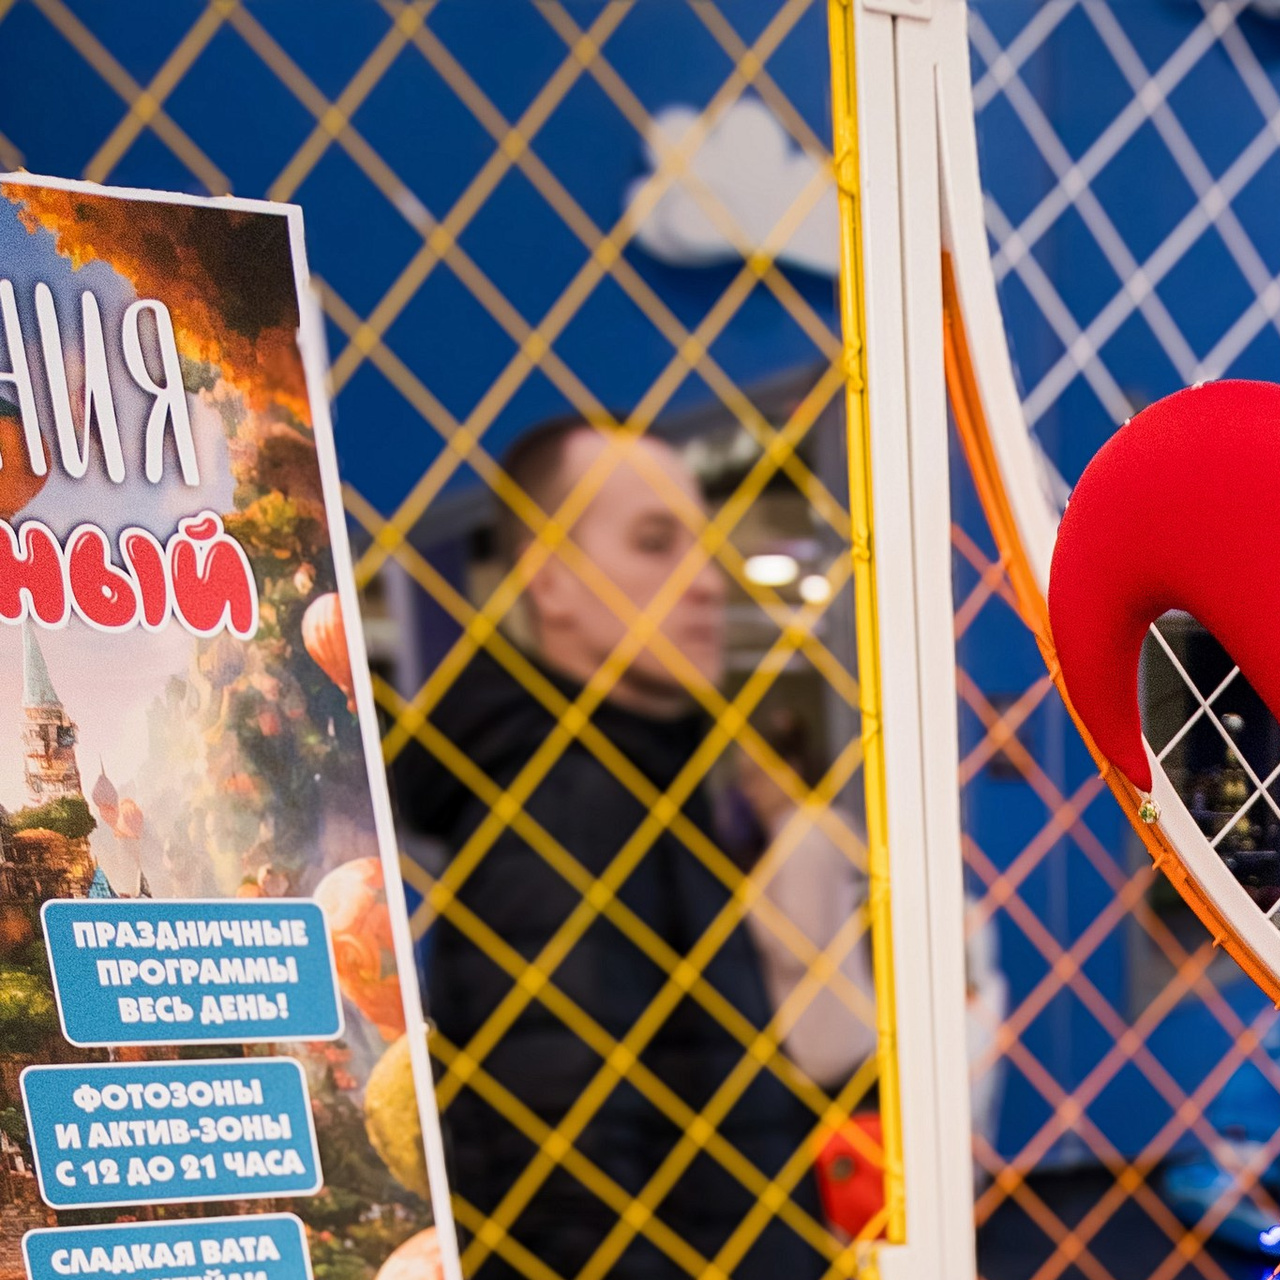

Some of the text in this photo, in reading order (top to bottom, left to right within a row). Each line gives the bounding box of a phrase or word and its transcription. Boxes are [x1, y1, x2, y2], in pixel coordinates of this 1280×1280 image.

[72, 919, 309, 950] ПРАЗДНИЧНЫЕ
[96, 956, 299, 986] ПРОГРАММЫ
[117, 992, 290, 1025] ВЕСЬ ДЕНЬ!
[72, 1078, 264, 1113] ФОТОЗОНЫ
[54, 1113, 293, 1149] И АКТИВ-ЗОНЫ
[55, 1148, 307, 1187] С 12 ДО 21 ЧАСА
[50, 1235, 281, 1275] СЛАДКАЯ ВАТА
